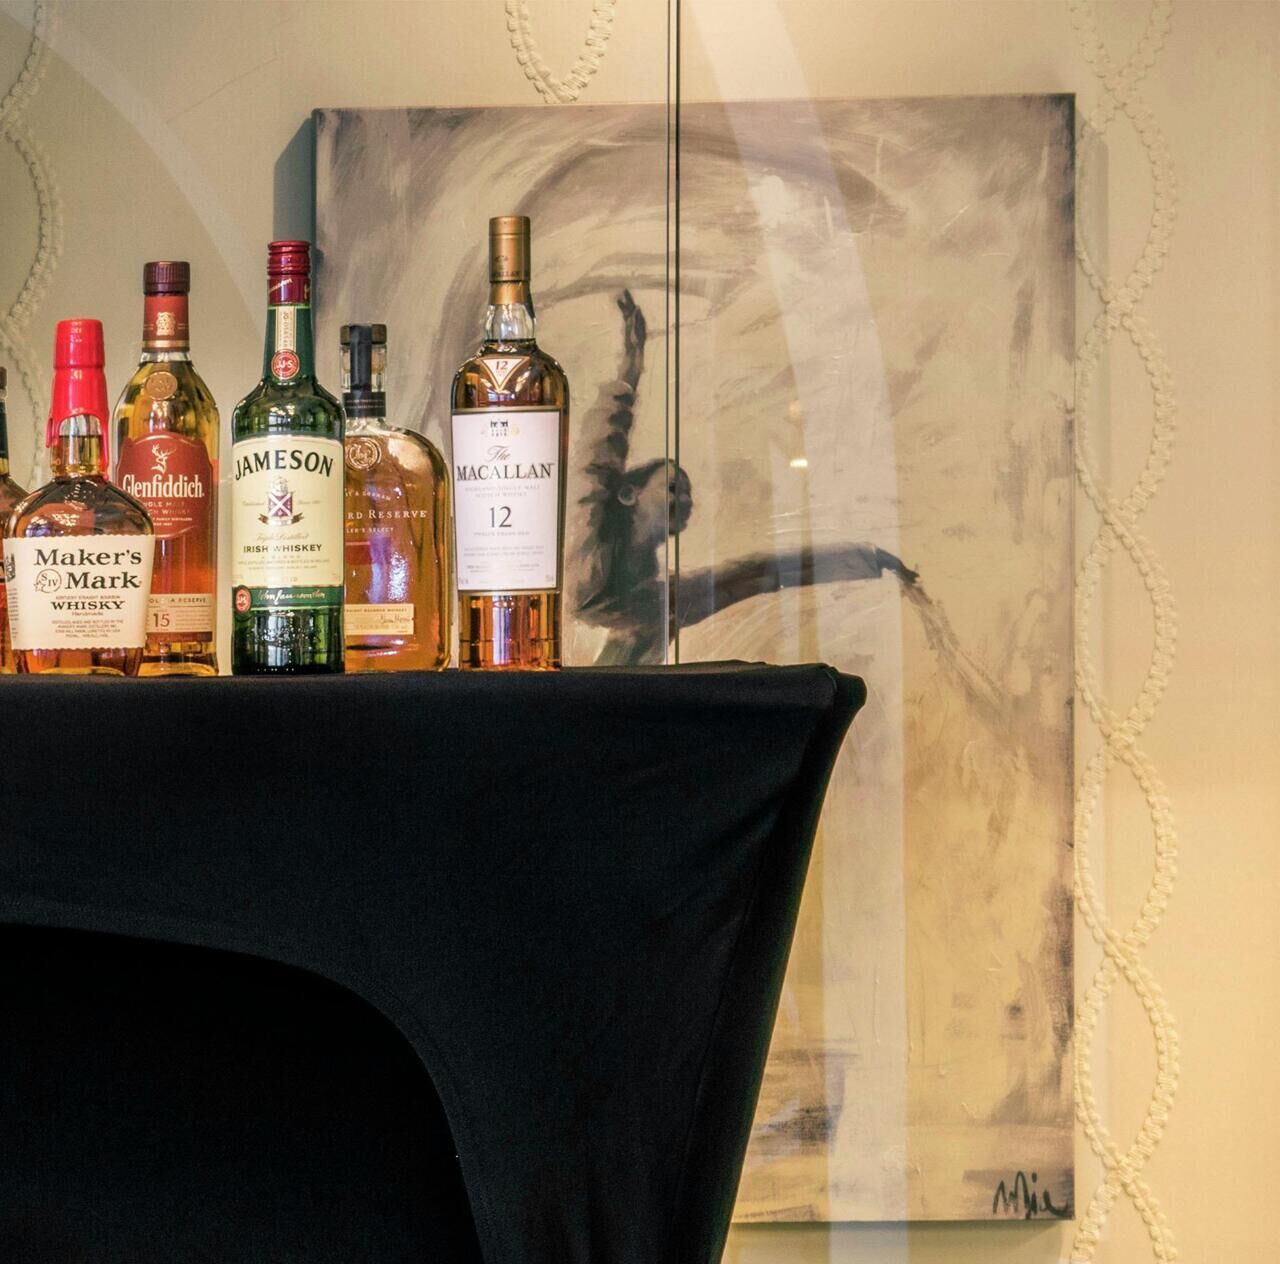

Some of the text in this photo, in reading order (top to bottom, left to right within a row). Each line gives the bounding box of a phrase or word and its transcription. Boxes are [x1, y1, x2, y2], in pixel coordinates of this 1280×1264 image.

[495, 359, 509, 371] 12
[482, 445, 512, 463] The
[234, 449, 334, 481] JAMESON
[456, 463, 552, 482] MACALLAN
[122, 473, 203, 499] Glenfiddich
[367, 510, 428, 520] RESERVE
[488, 505, 513, 529] 12
[33, 548, 143, 567] Maker's
[243, 543, 323, 554] IRISH WHISKEY
[64, 571, 141, 590] Mark
[50, 600, 126, 610] WHISKY
[153, 613, 171, 628] 15
